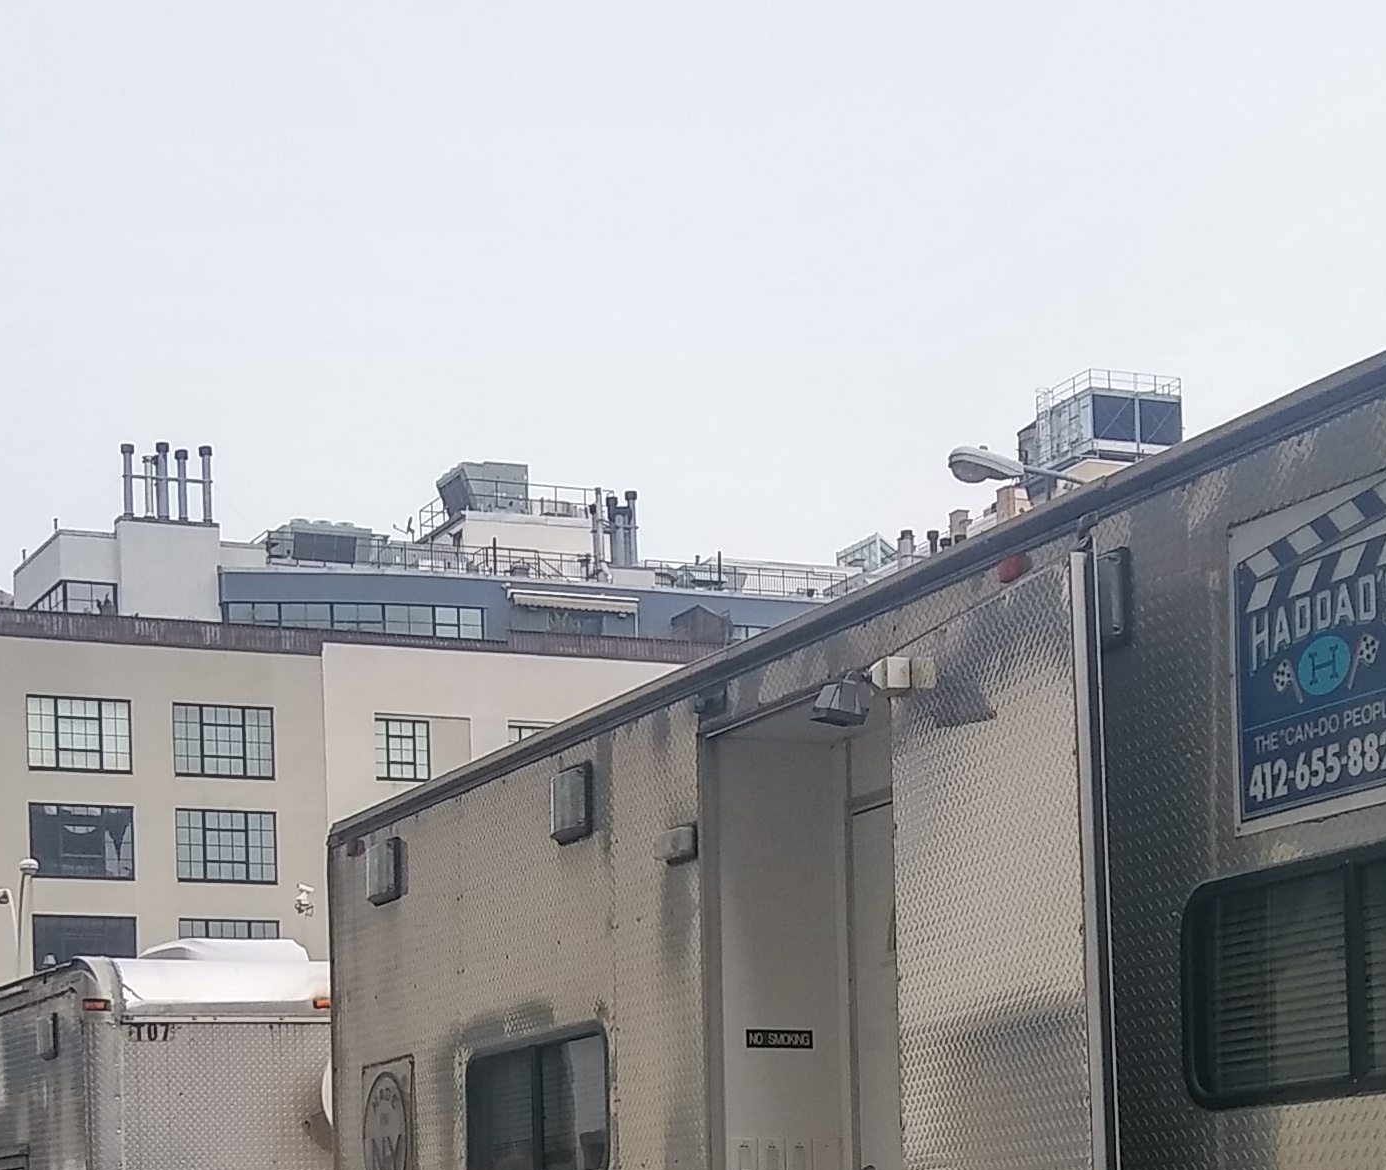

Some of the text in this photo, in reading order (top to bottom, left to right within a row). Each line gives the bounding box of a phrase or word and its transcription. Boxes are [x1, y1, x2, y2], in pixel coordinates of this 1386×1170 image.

[1253, 731, 1280, 754] THE
[749, 1032, 811, 1046] NO SMOKING
